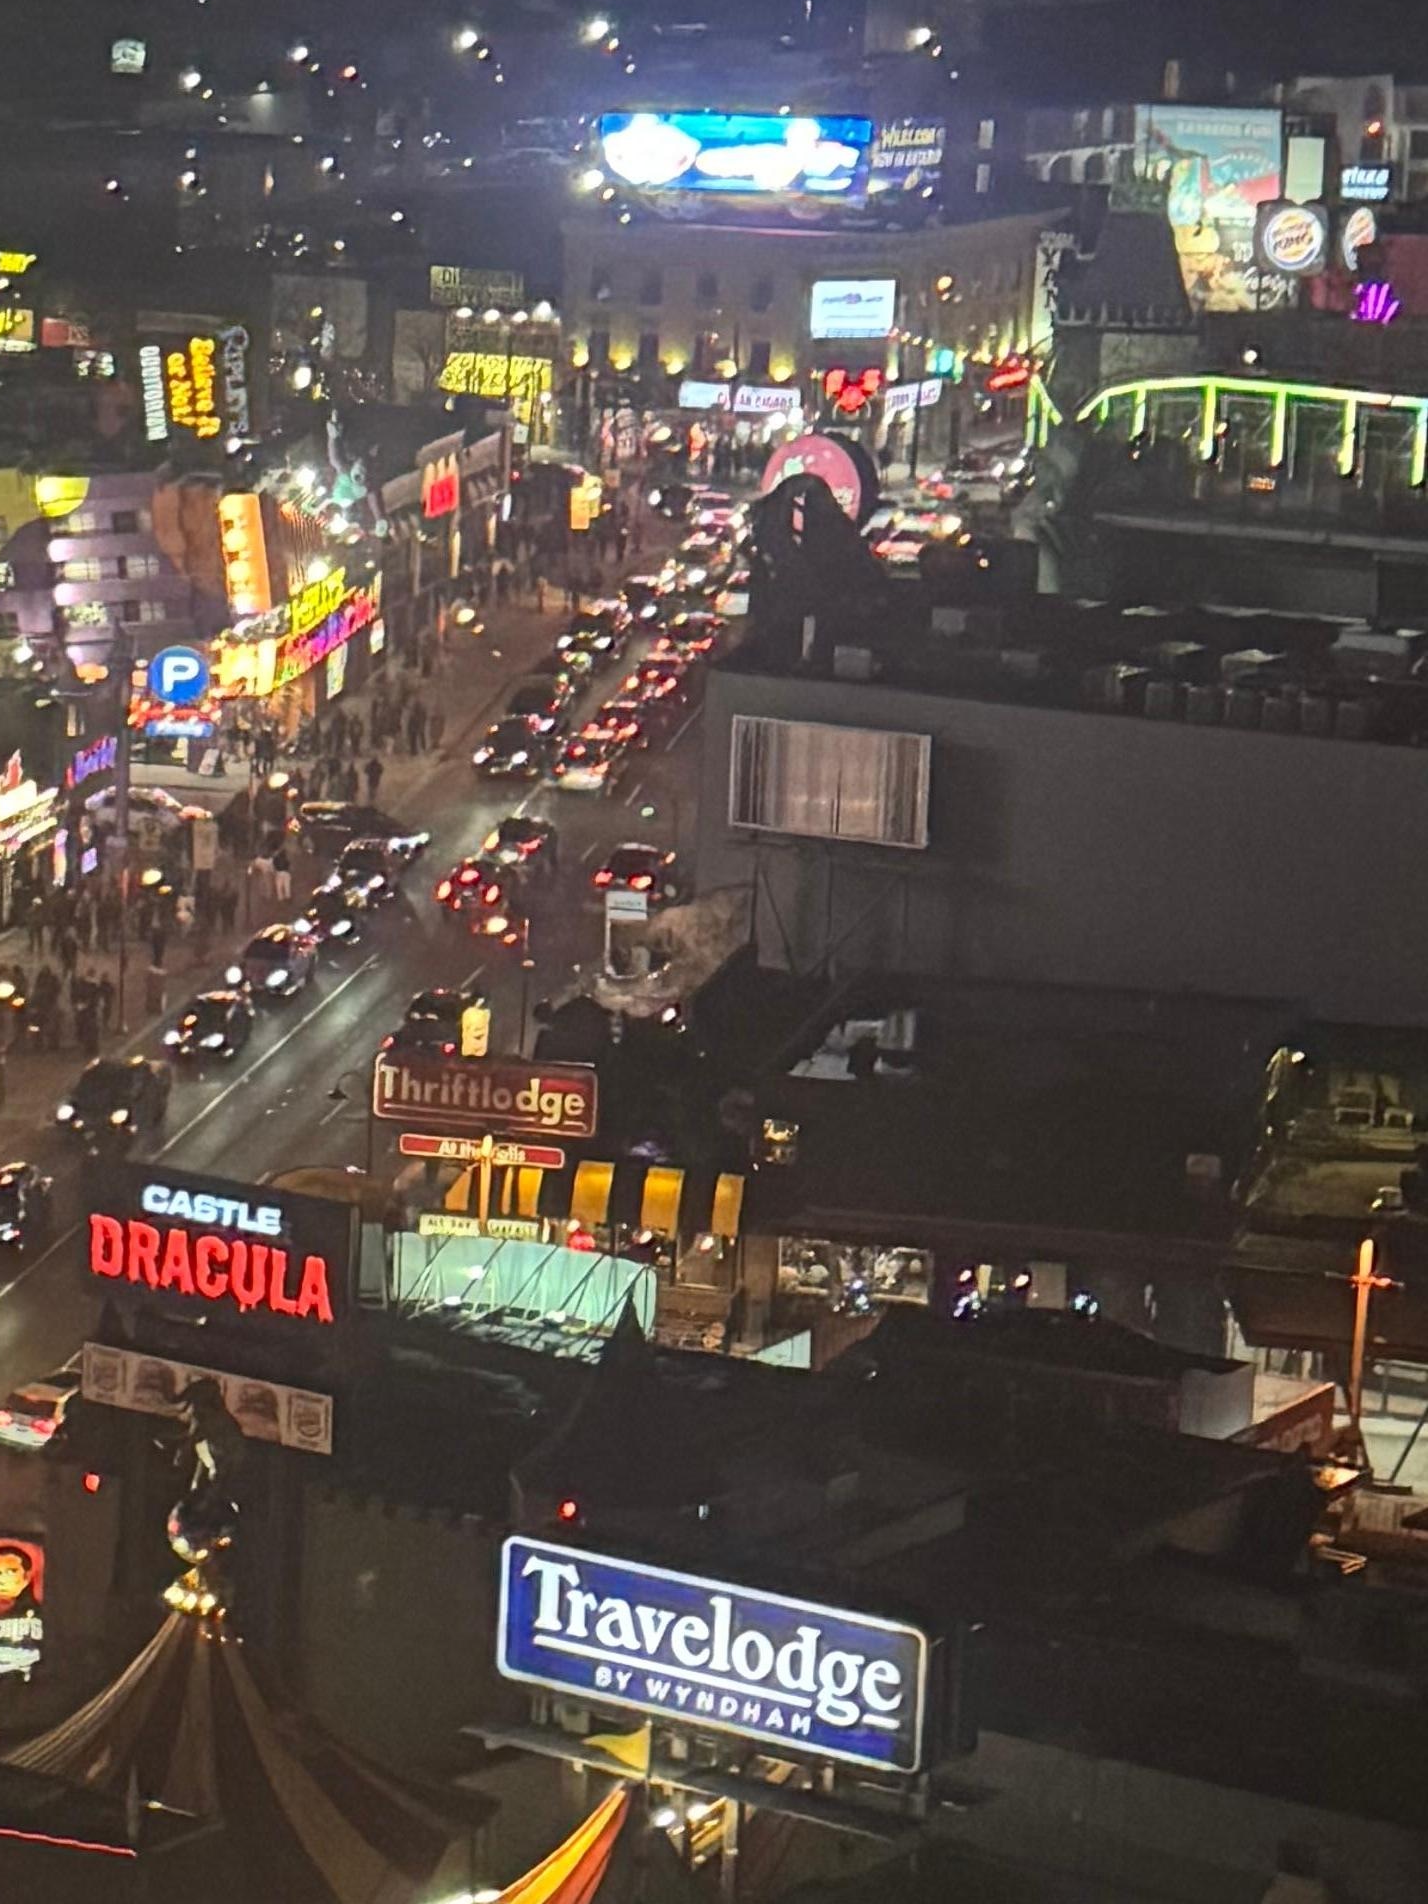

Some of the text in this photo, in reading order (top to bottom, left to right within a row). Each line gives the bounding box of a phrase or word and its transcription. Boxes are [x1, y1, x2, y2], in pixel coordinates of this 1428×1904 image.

[379, 1064, 586, 1126] Thriftlodge
[143, 1183, 283, 1237] CASTLE
[90, 1212, 335, 1324] DRACULA
[522, 1555, 903, 1727] Travelodge
[594, 1666, 813, 1737] BY WYNDHAM
